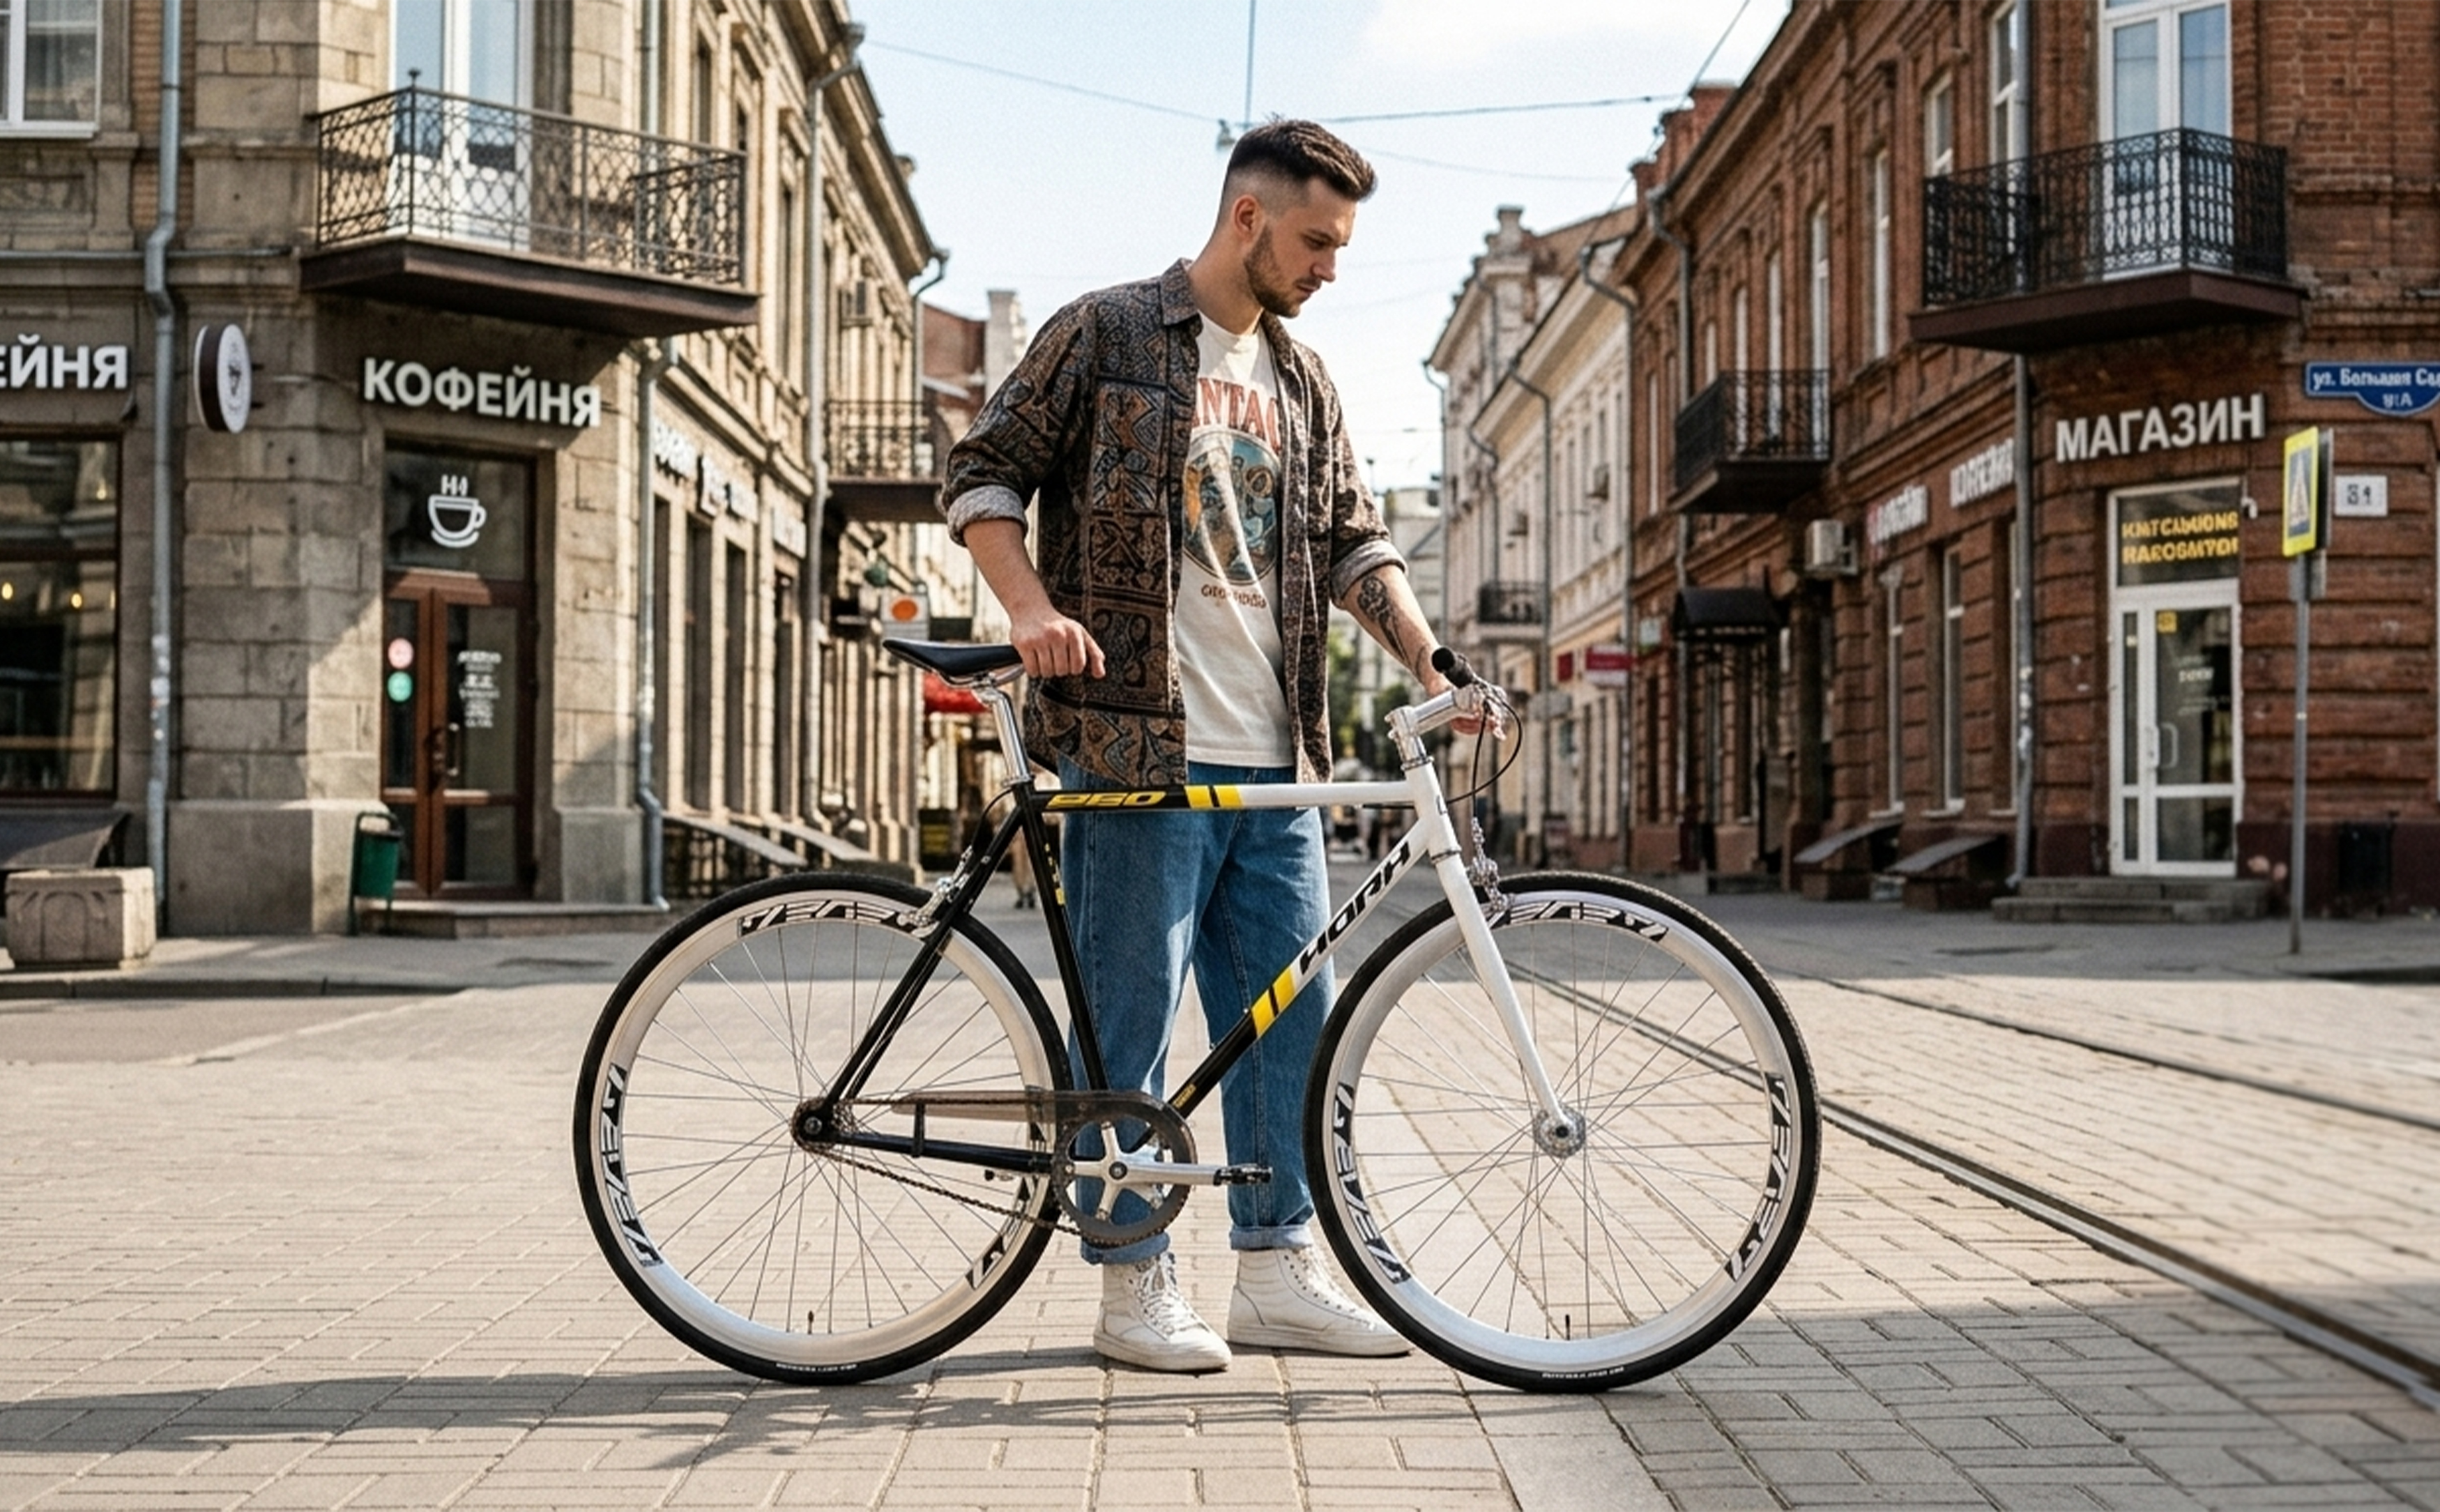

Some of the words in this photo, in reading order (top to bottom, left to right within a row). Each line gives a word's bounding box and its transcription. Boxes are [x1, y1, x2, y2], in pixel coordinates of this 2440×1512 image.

[0, 334, 128, 389] ЙНЯ
[363, 357, 601, 428] КОФЕЙНЯ
[2056, 392, 2264, 463] МАГАЗИН
